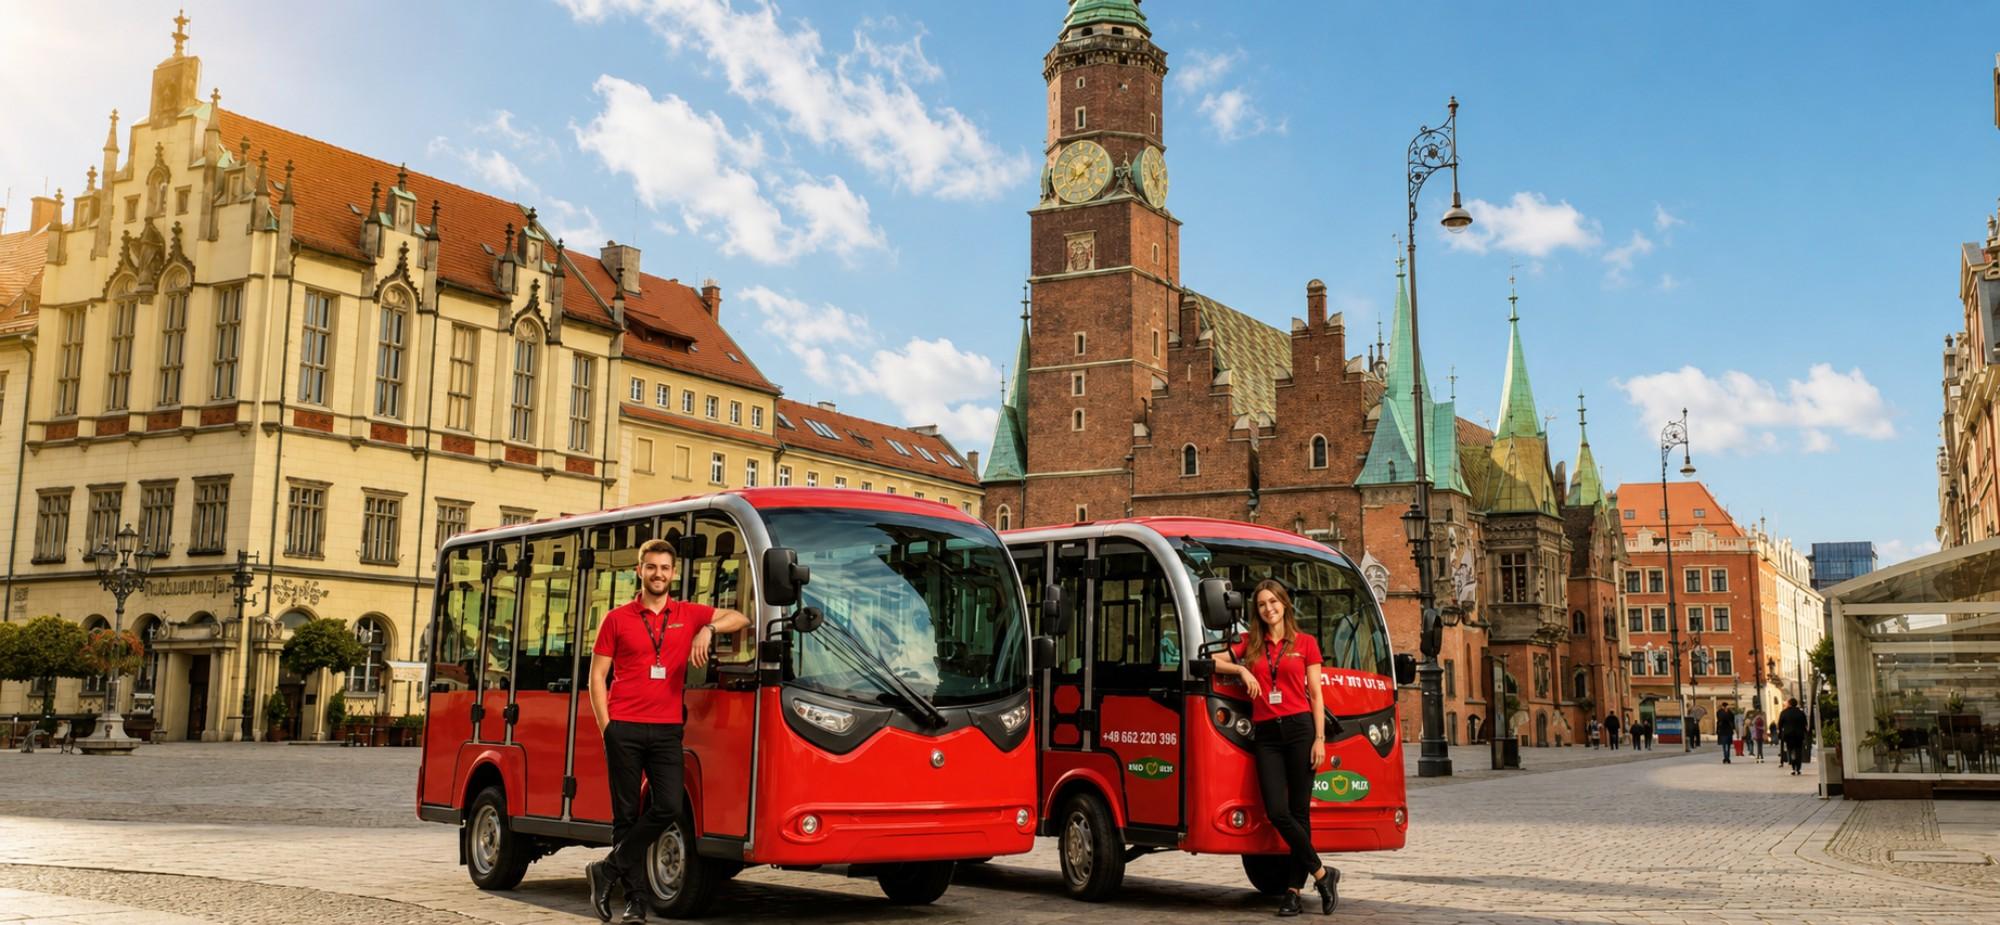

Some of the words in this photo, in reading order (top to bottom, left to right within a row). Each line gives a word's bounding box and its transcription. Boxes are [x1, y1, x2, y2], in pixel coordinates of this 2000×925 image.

[1103, 731, 1120, 743] +48
[1121, 731, 1138, 744] 662
[1140, 732, 1157, 745] 220
[1159, 733, 1177, 745] 396
